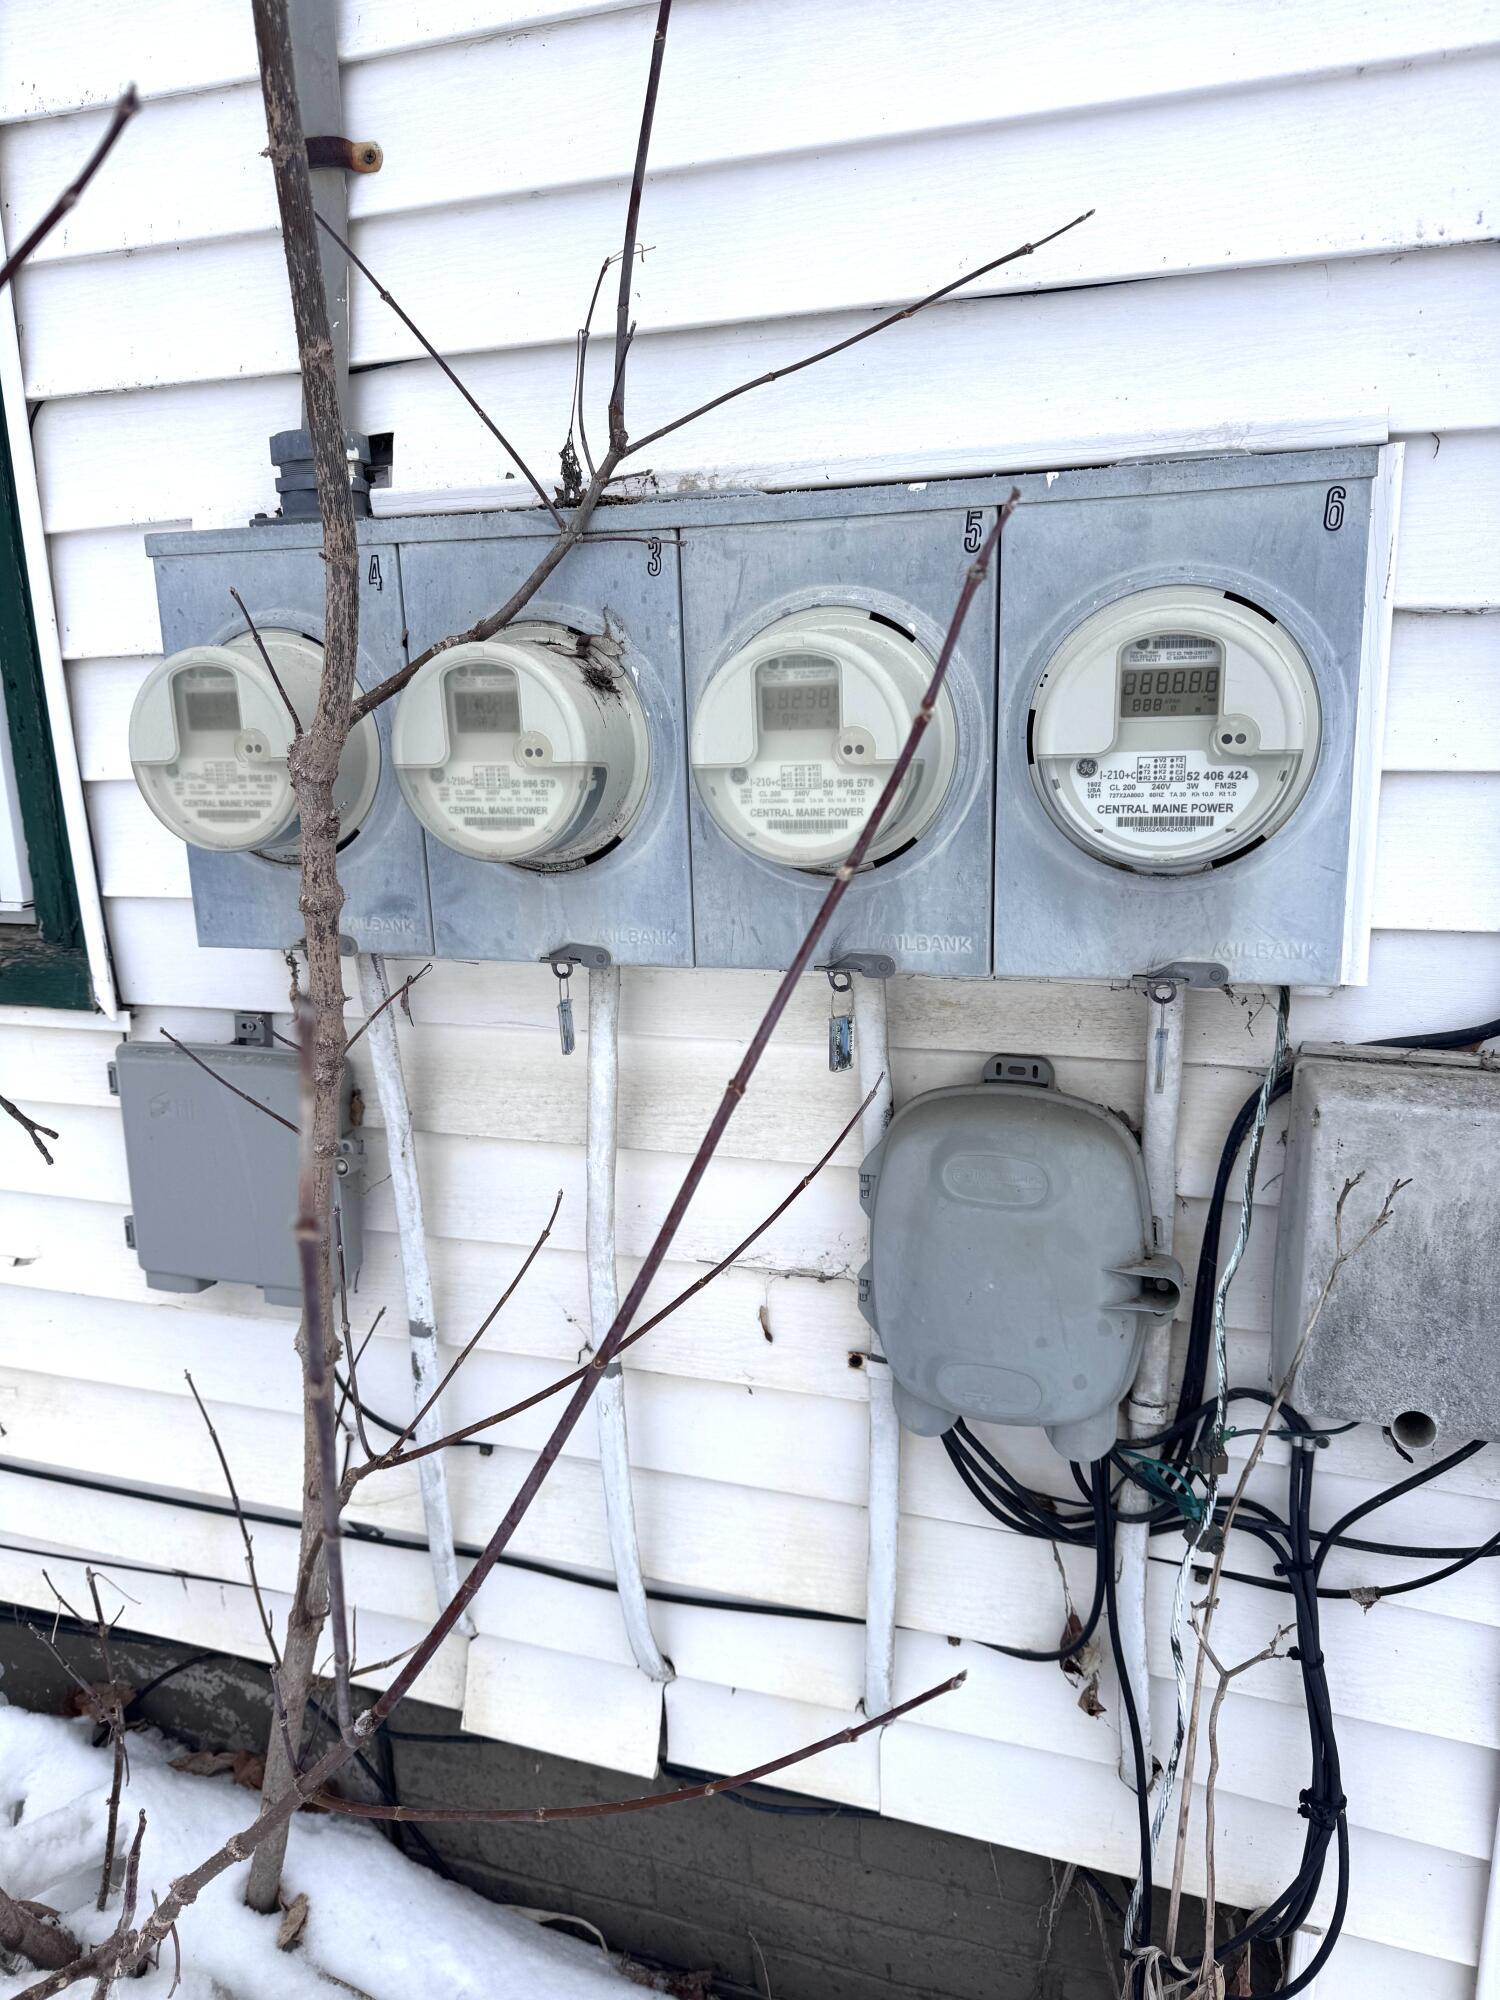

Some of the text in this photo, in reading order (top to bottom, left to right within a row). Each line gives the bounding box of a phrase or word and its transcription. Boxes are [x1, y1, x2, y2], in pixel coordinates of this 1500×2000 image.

[1323, 486, 1346, 531] 6
[964, 510, 983, 553] 5
[647, 537, 661, 576] 3
[368, 555, 382, 591] 4
[1187, 772, 1200, 781] 52
[1203, 771, 1224, 780] 406
[1227, 771, 1248, 780] 424
[448, 806, 548, 815] CENTRAL MAINE POWER
[750, 807, 864, 818] CENTRAL MAINE POWER
[1097, 803, 1234, 814] CENTRAL MAINE POWER
[879, 934, 971, 953] MILBANK
[1211, 941, 1320, 961] MILBANK
